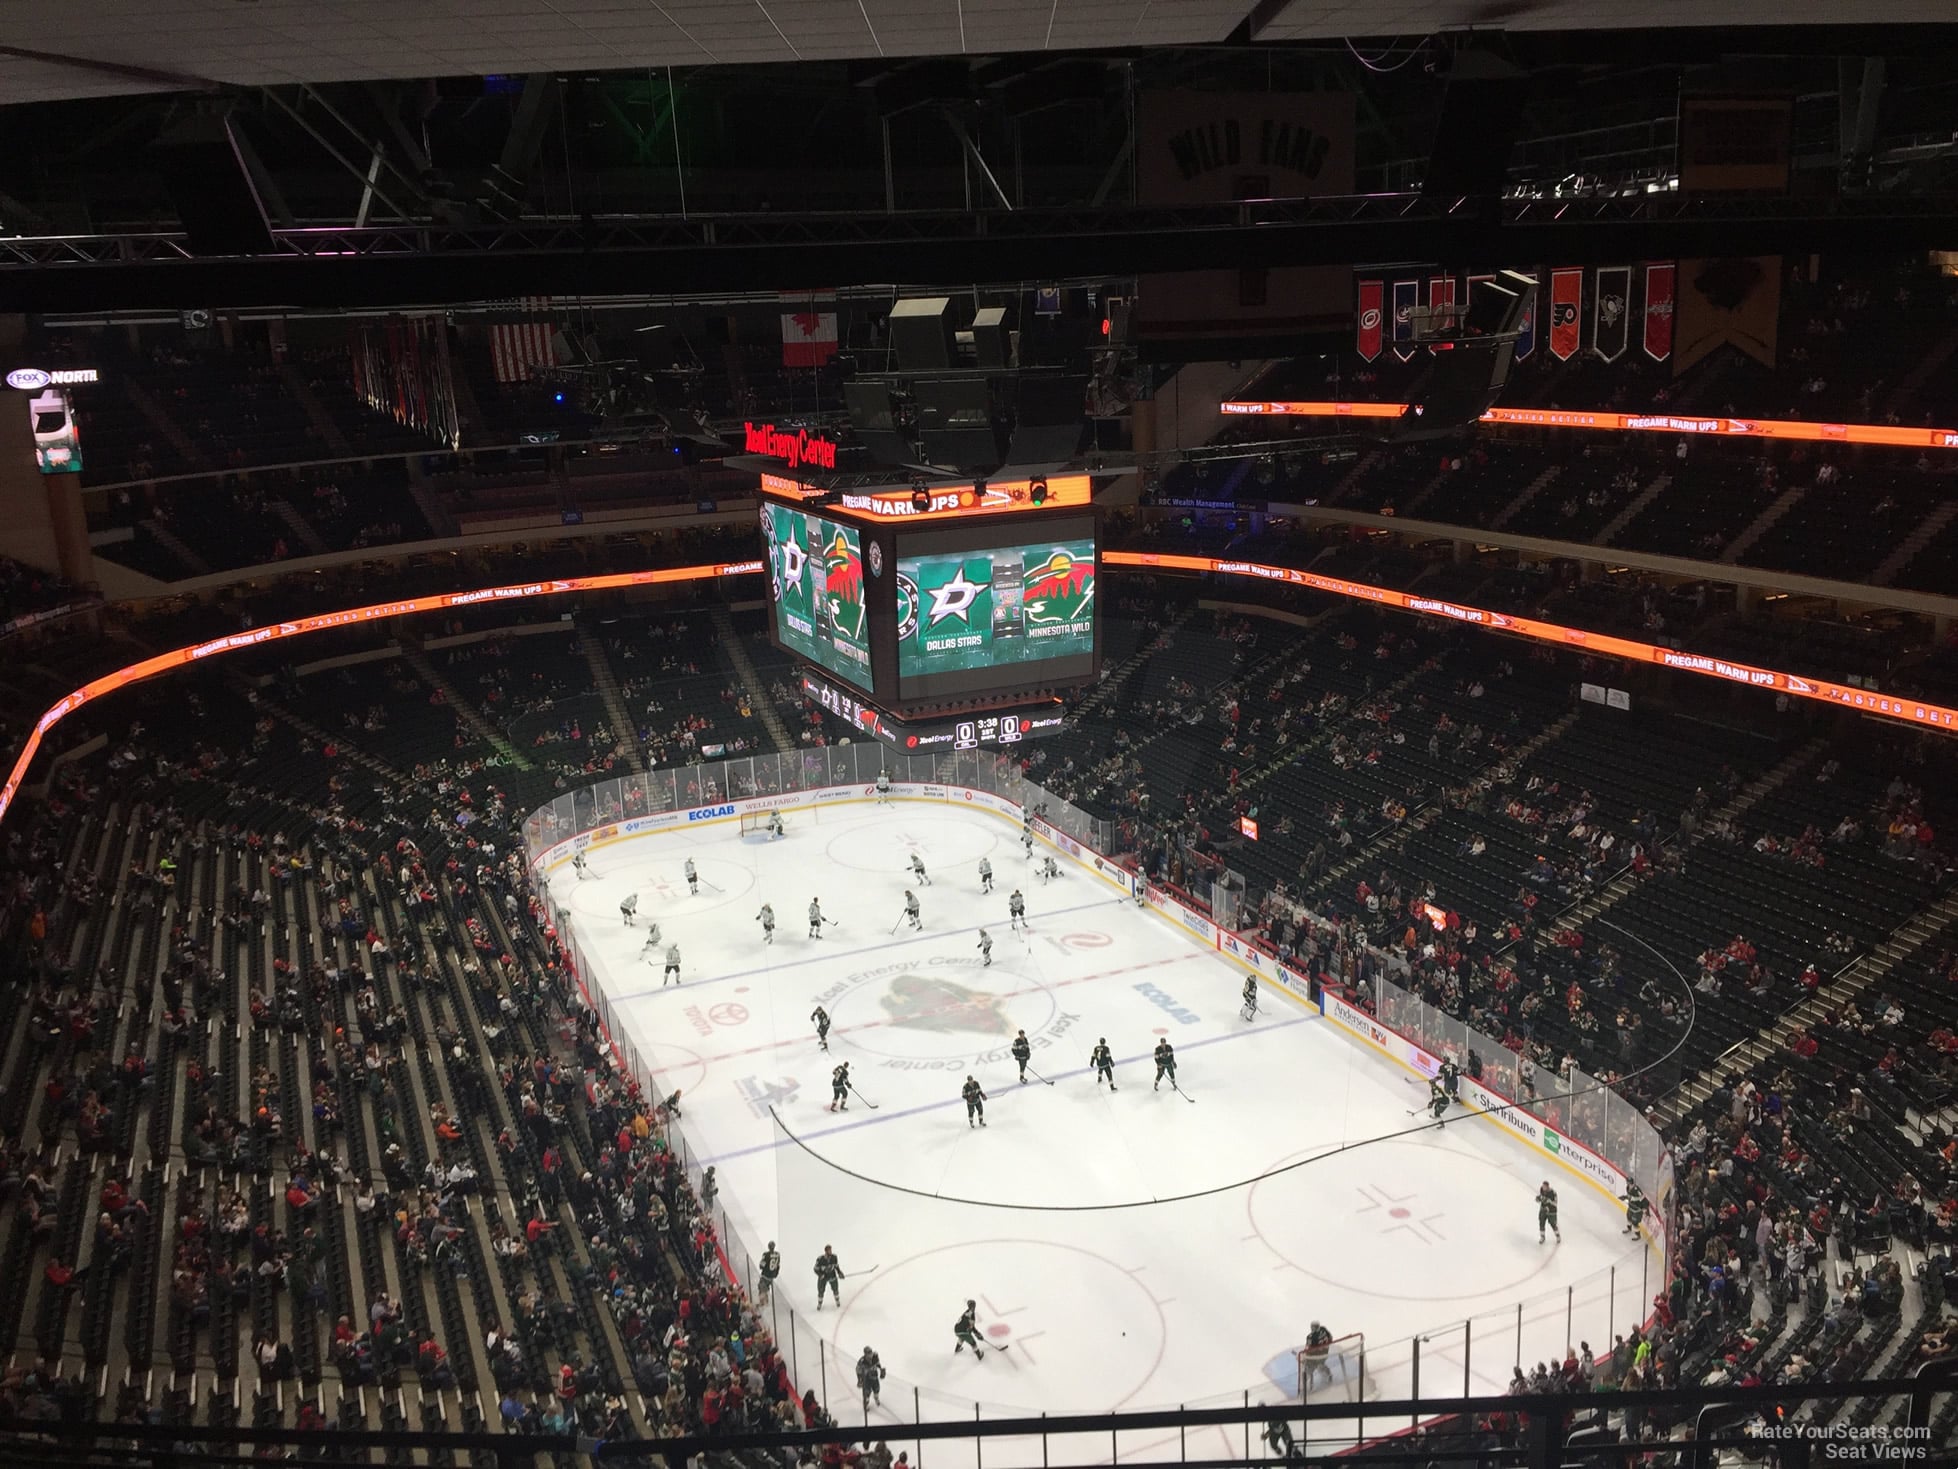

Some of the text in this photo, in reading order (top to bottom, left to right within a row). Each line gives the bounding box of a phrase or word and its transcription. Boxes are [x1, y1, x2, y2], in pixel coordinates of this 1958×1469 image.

[1168, 119, 1330, 181] WILD FANS
[16, 369, 98, 384] FOX NORTH
[1627, 418, 1718, 431] PREGAME WARM UPS
[744, 421, 837, 468] Xcel Energy Center
[842, 494, 872, 510] PREGAME
[722, 562, 762, 575] PREGAME
[1218, 562, 1284, 578] PREGAME WARM UPS
[451, 584, 542, 605] PREGAME WARM UPS
[1410, 599, 1482, 621] PREGAME WARM UPS
[1028, 622, 1070, 638] MINNESOTA
[1072, 622, 1090, 634] WILD
[192, 628, 272, 658] PREGAME WARM UPS
[926, 638, 956, 651] DALLAS
[957, 636, 982, 647] STARS
[1664, 653, 1774, 685] PREGAME WARM UPS
[978, 718, 998, 729] 3:38
[1916, 707, 1958, 725] BET
[960, 725, 971, 741] 0
[1004, 718, 1015, 734] 0
[919, 734, 954, 745] Xcel Energy
[746, 796, 800, 810] WELLS FARGO
[688, 805, 735, 821] ECOLAB
[850, 959, 921, 984] Energy
[1334, 1002, 1370, 1031] Andersen
[878, 1057, 965, 1072] Center
[1480, 1093, 1536, 1138] StarTribune
[1545, 1132, 1615, 1186] enterprise
